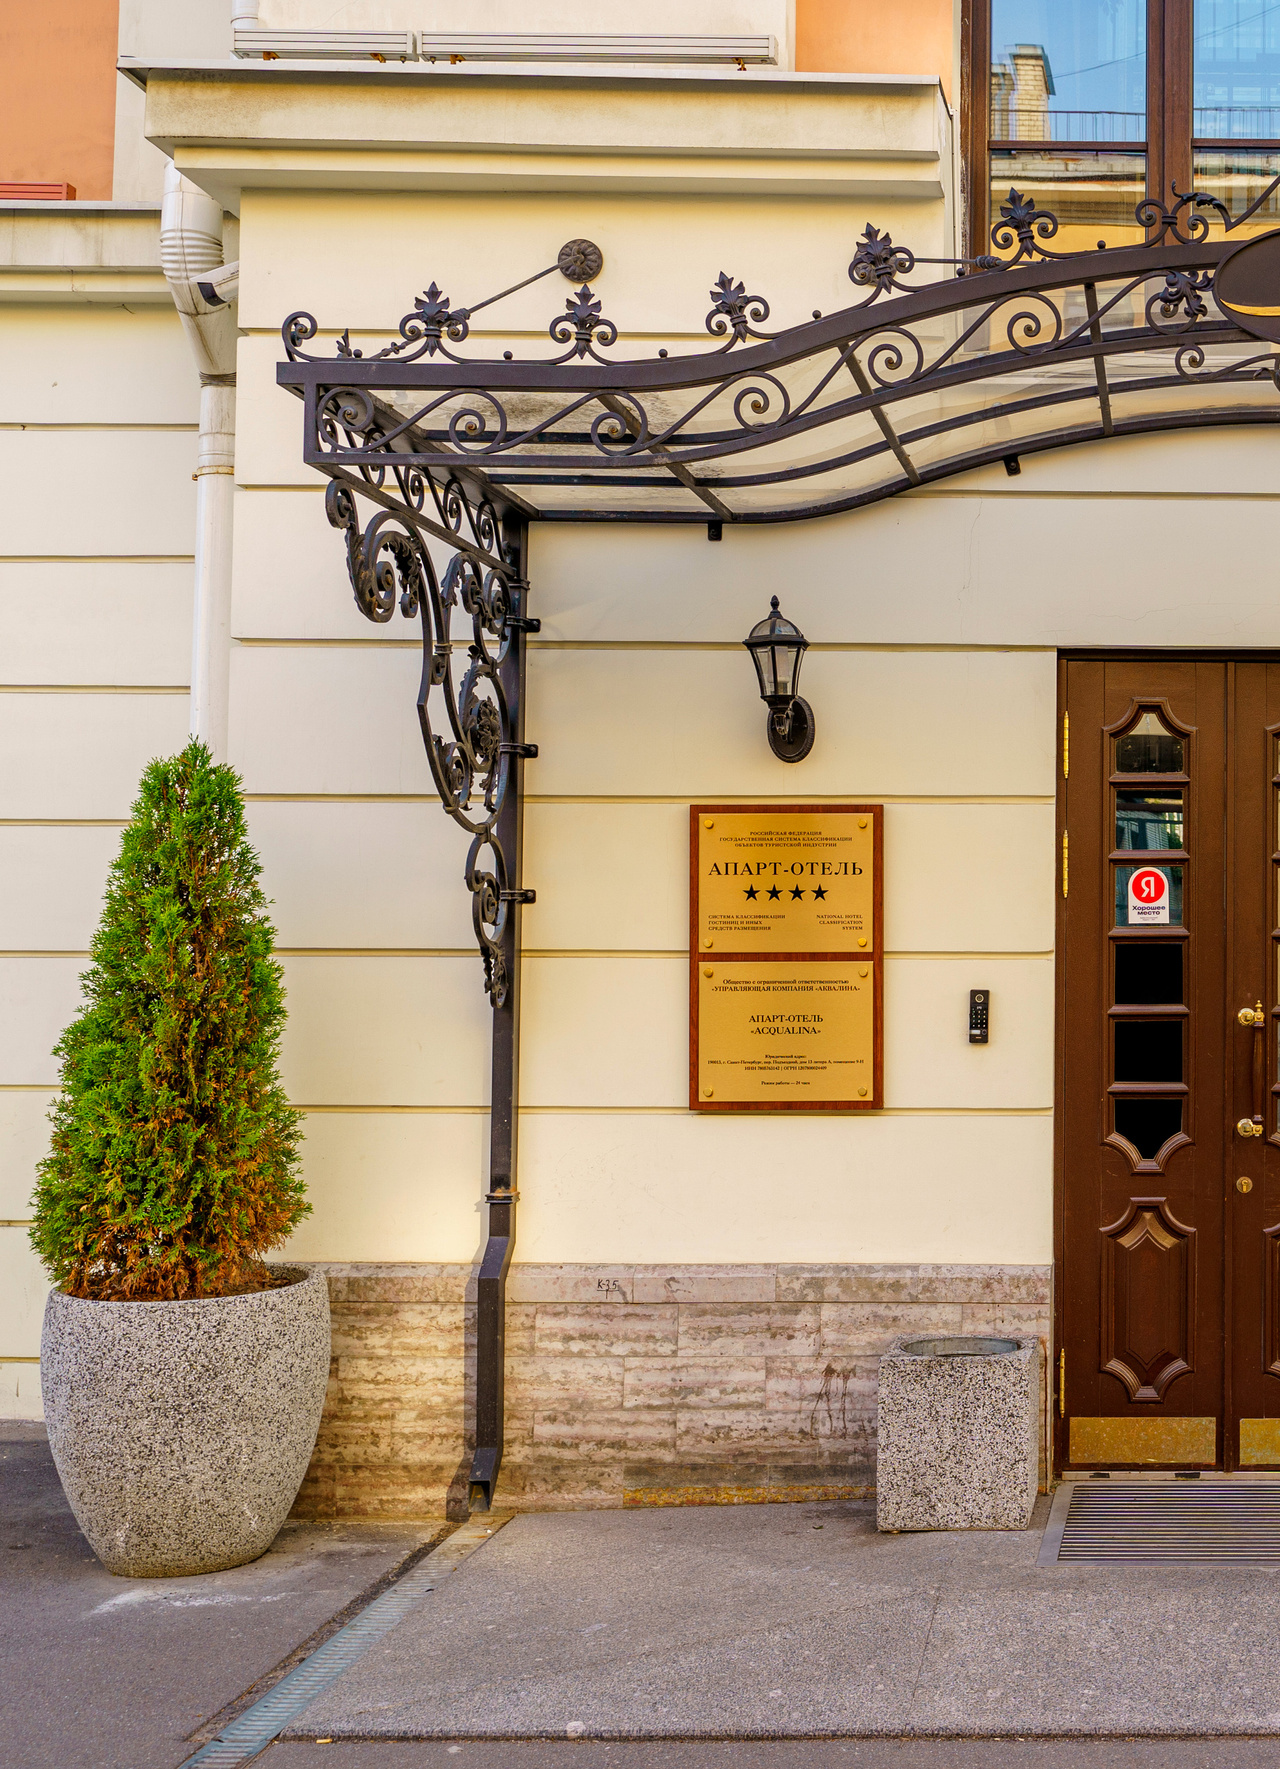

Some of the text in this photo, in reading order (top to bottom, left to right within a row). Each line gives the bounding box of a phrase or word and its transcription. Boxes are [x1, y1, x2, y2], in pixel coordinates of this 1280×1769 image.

[708, 862, 863, 876] АПАРТ-ОТЕЛЬ
[1141, 876, 1155, 898] Я
[748, 1014, 824, 1023] АПАРТ-ОТЕЛЬ
